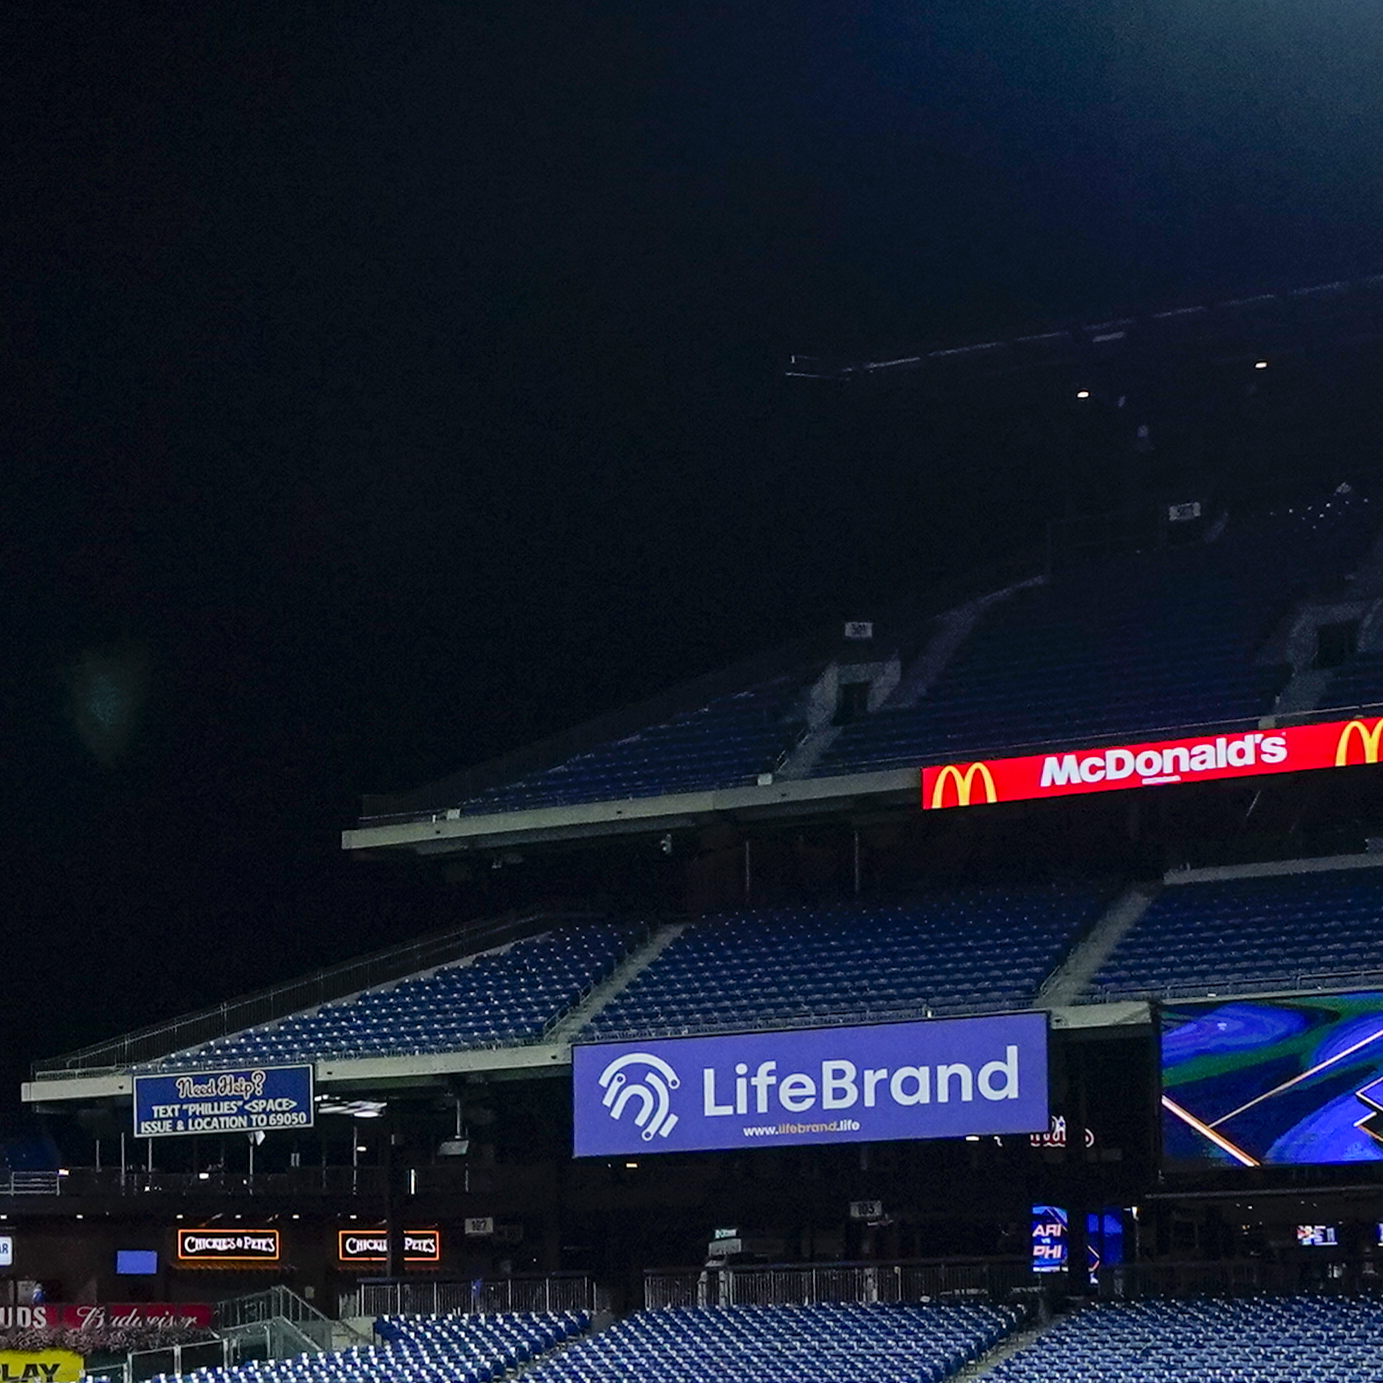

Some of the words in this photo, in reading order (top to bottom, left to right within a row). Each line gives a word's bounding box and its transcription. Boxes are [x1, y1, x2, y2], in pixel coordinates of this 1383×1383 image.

[1040, 734, 1288, 788] McDonald's
[176, 1076, 216, 1099] Need
[217, 1070, 266, 1100] Help?
[703, 1045, 1020, 1118] LifeBrand
[152, 1104, 181, 1118] TEXT
[244, 1098, 297, 1113] <SPACE>
[141, 1120, 172, 1133] ISSUE
[176, 1119, 185, 1131] &
[188, 1116, 248, 1130] LOCATION
[249, 1114, 268, 1127] TO
[269, 1112, 307, 1126] 69050
[742, 1119, 861, 1139] www.lifebrand.life
[1032, 1224, 1062, 1237] ARI
[243, 1238, 276, 1254] PETE'S
[404, 1238, 436, 1254] PETE'S
[1033, 1245, 1062, 1258] PHI
